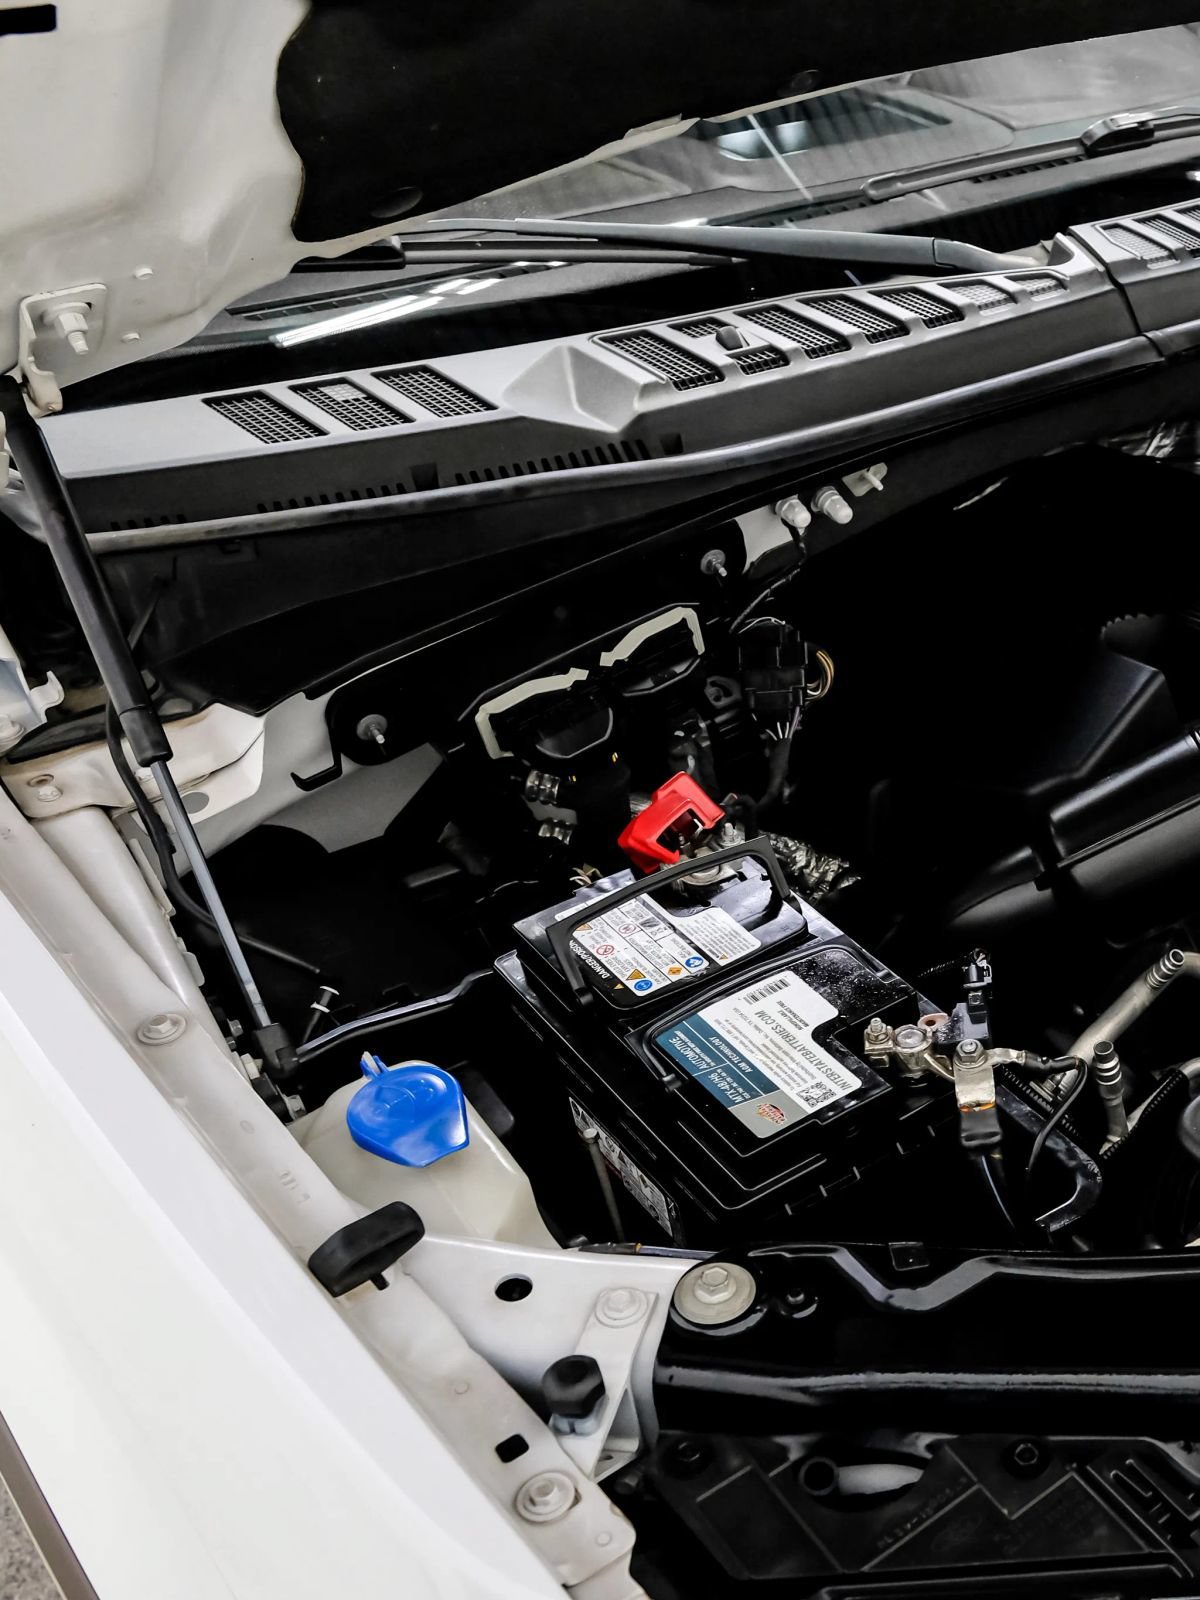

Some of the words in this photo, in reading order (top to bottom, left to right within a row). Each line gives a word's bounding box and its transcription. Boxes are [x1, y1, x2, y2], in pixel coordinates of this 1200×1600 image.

[569, 940, 610, 979] DANGER/POISON
[667, 1035, 710, 1070] AUTOMOTIVE
[707, 1036, 742, 1063] TECHNOLOGY
[753, 1009, 853, 1091] INTERSTATEBATTERIES.COM
[736, 1060, 754, 1074] AGM
[705, 1071, 745, 1103] MTX-48/H6
